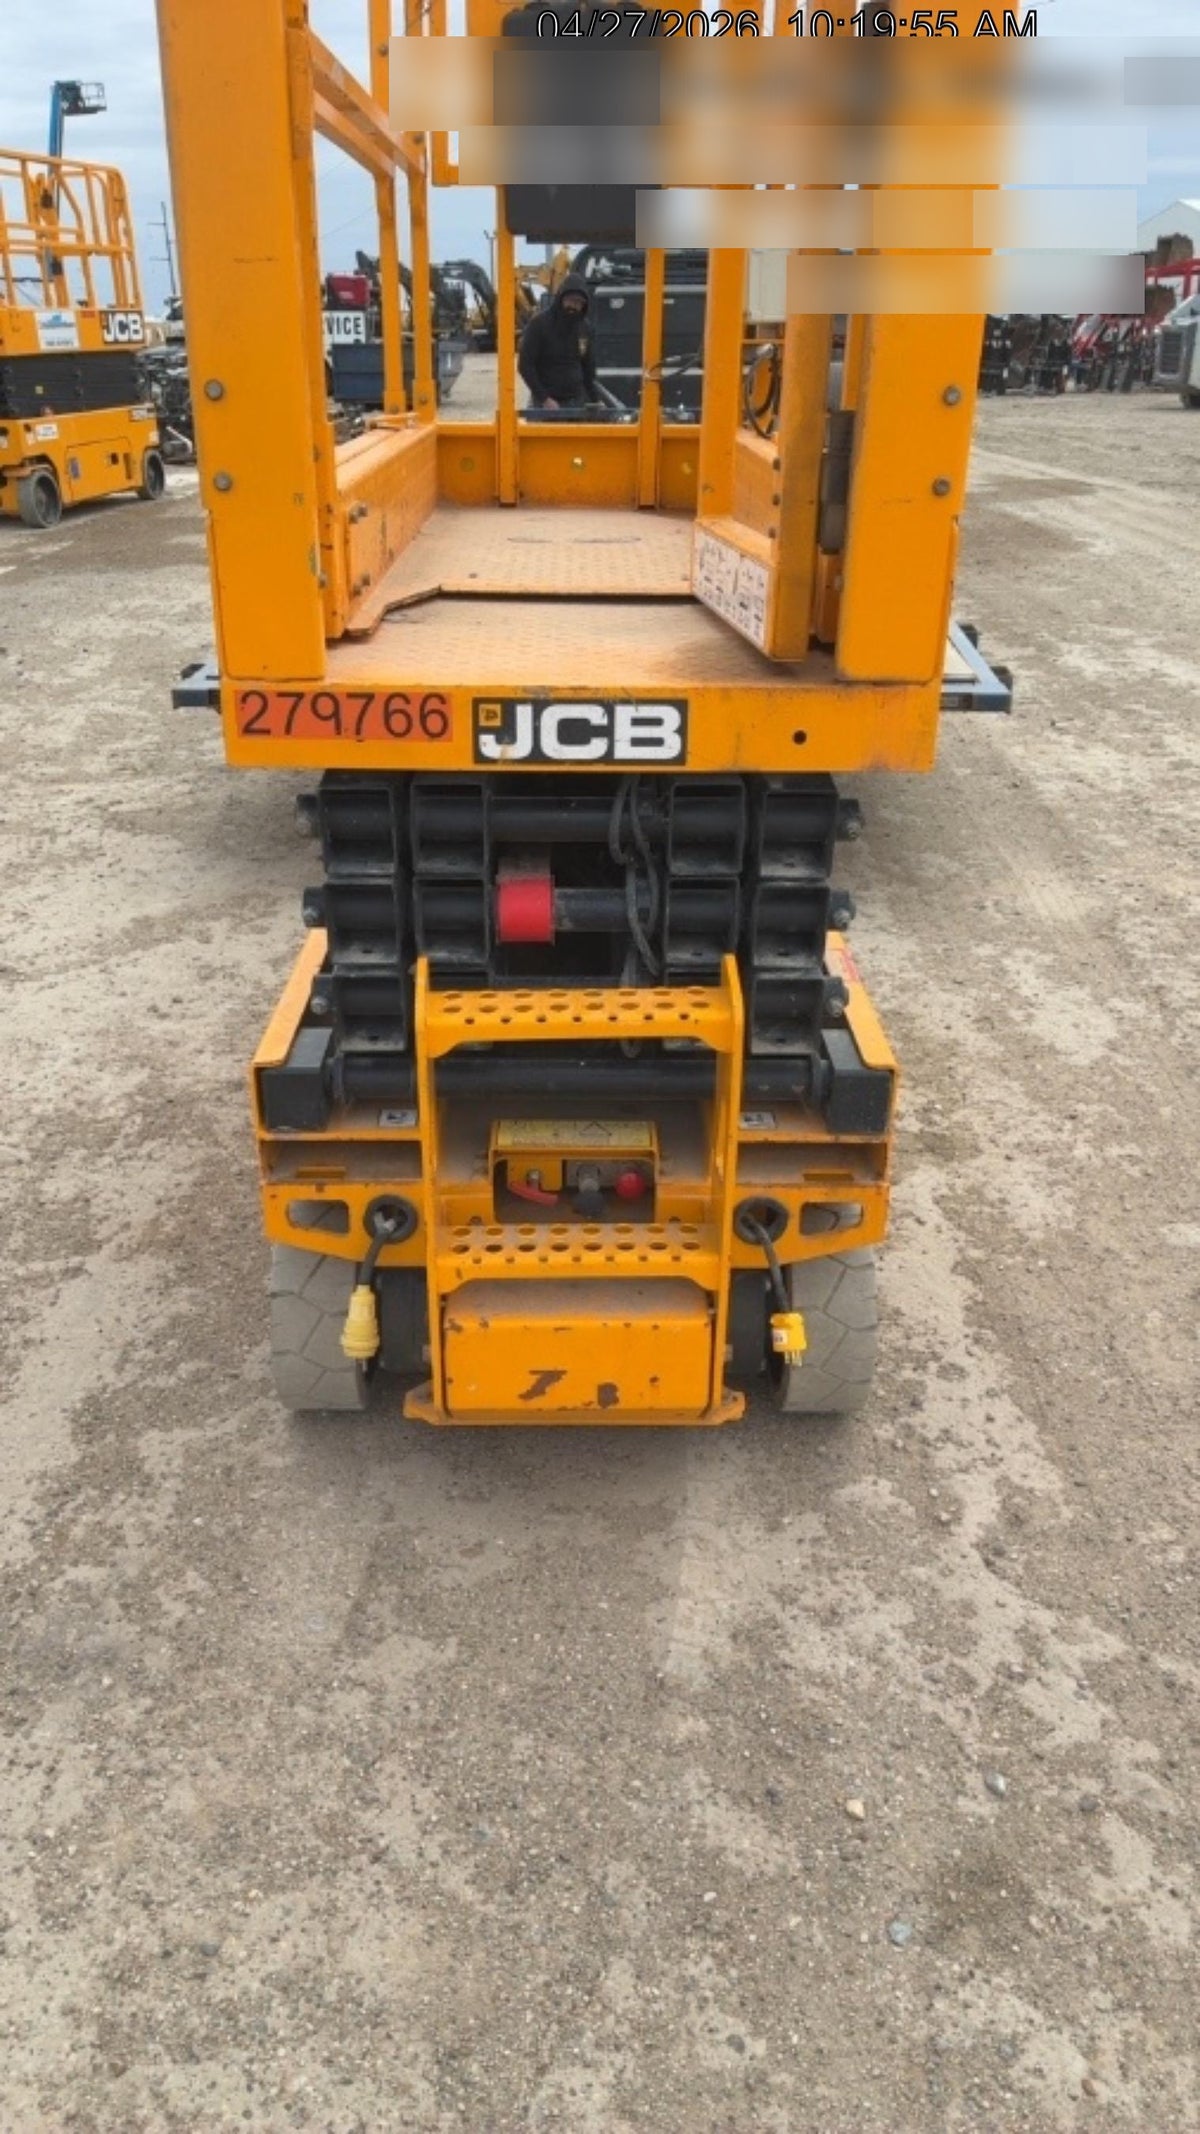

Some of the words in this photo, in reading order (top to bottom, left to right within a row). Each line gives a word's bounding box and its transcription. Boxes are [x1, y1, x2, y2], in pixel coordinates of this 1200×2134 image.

[103, 312, 144, 342] JCB
[324, 316, 361, 336] VICE
[240, 690, 449, 741] 279766
[478, 703, 683, 761] JCB
